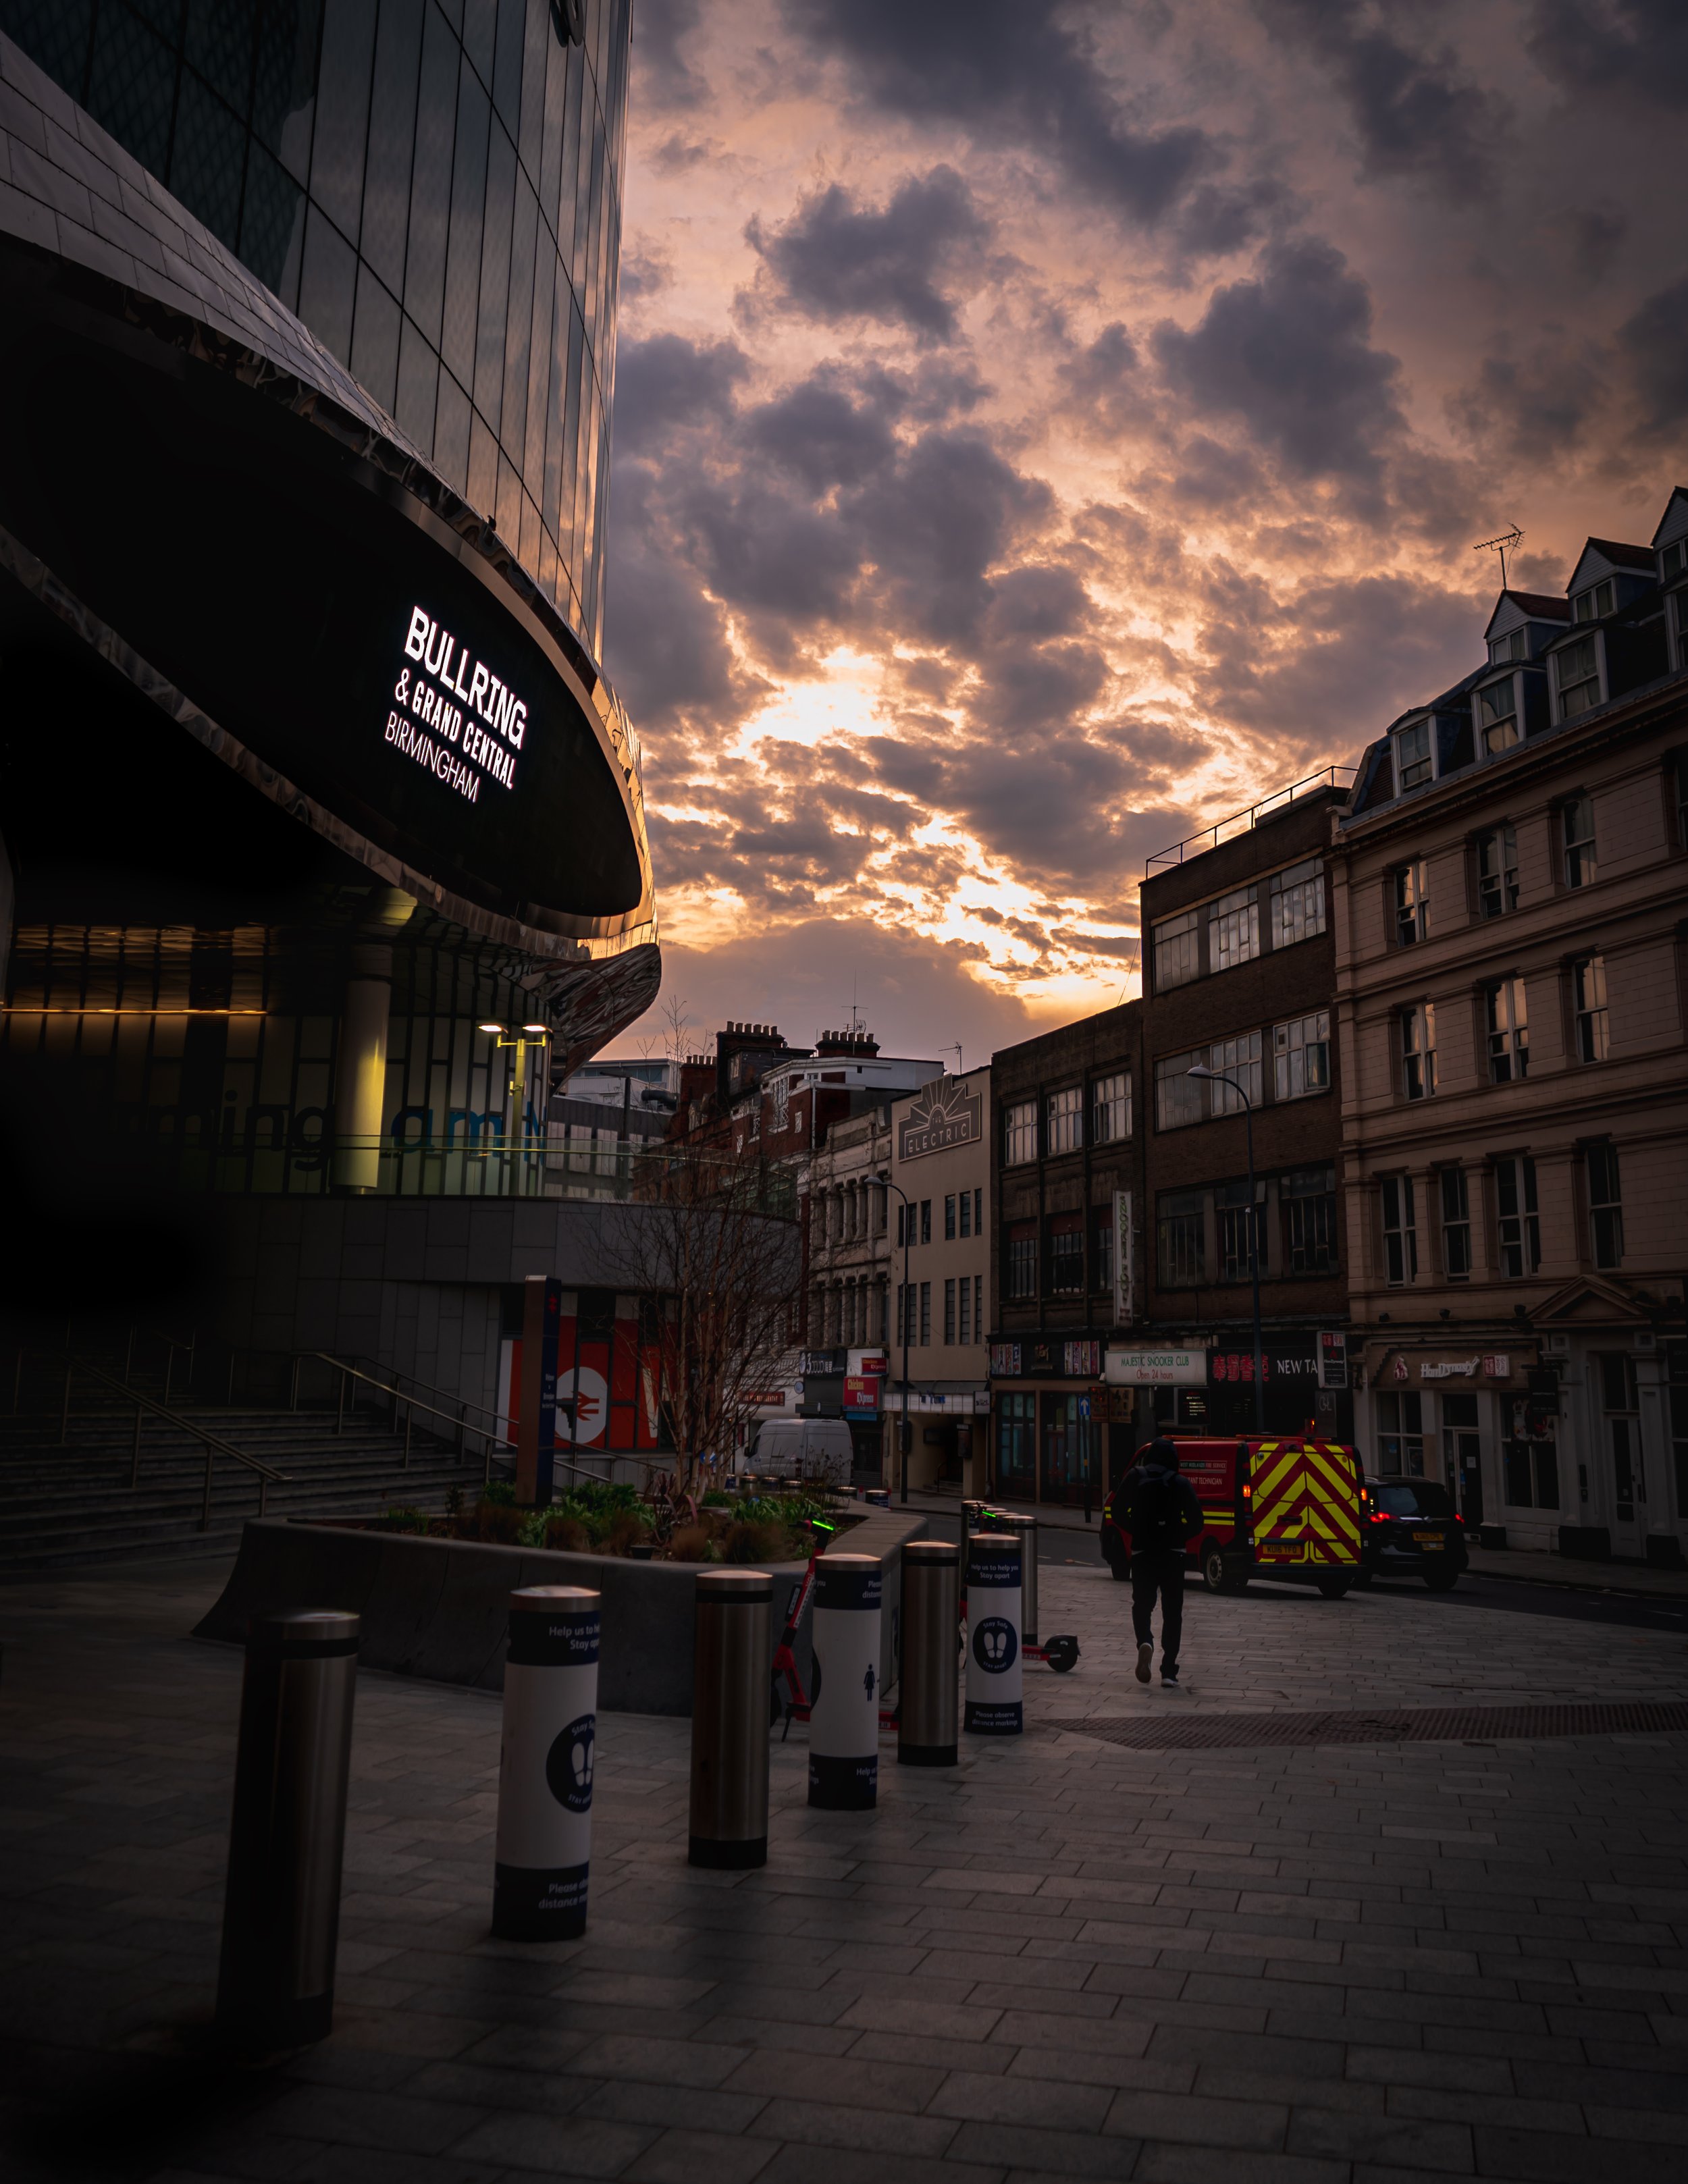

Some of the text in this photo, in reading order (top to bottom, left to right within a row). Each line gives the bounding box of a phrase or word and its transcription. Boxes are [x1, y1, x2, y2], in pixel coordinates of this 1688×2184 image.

[404, 606, 527, 750] BULLRING
[395, 668, 516, 789] & GRAND CENTRAL
[385, 711, 479, 803] BIRMINGHAM
[907, 1123, 967, 1153] ELECTRIC
[1121, 1356, 1190, 1366] MAJESTIC SNOOKER CLUB
[1277, 1358, 1319, 1375] NEW TA
[1136, 1368, 1173, 1379] Open 24 hours
[1198, 1476, 1223, 1485] TECHNICIAN
[971, 1564, 982, 1572] Help
[998, 1564, 1010, 1572] help
[980, 1572, 1010, 1580] Stay apart
[549, 1625, 573, 1639] Help
[574, 1627, 585, 1636] us
[585, 1625, 594, 1636] to
[570, 1639, 589, 1652] Stay
[975, 1710, 994, 1718] Please
[571, 1723, 588, 1737] Stay
[855, 1767, 870, 1777] Help
[568, 1793, 583, 1805] STAY
[549, 1882, 578, 1894] Please
[538, 1896, 578, 1910] distance
